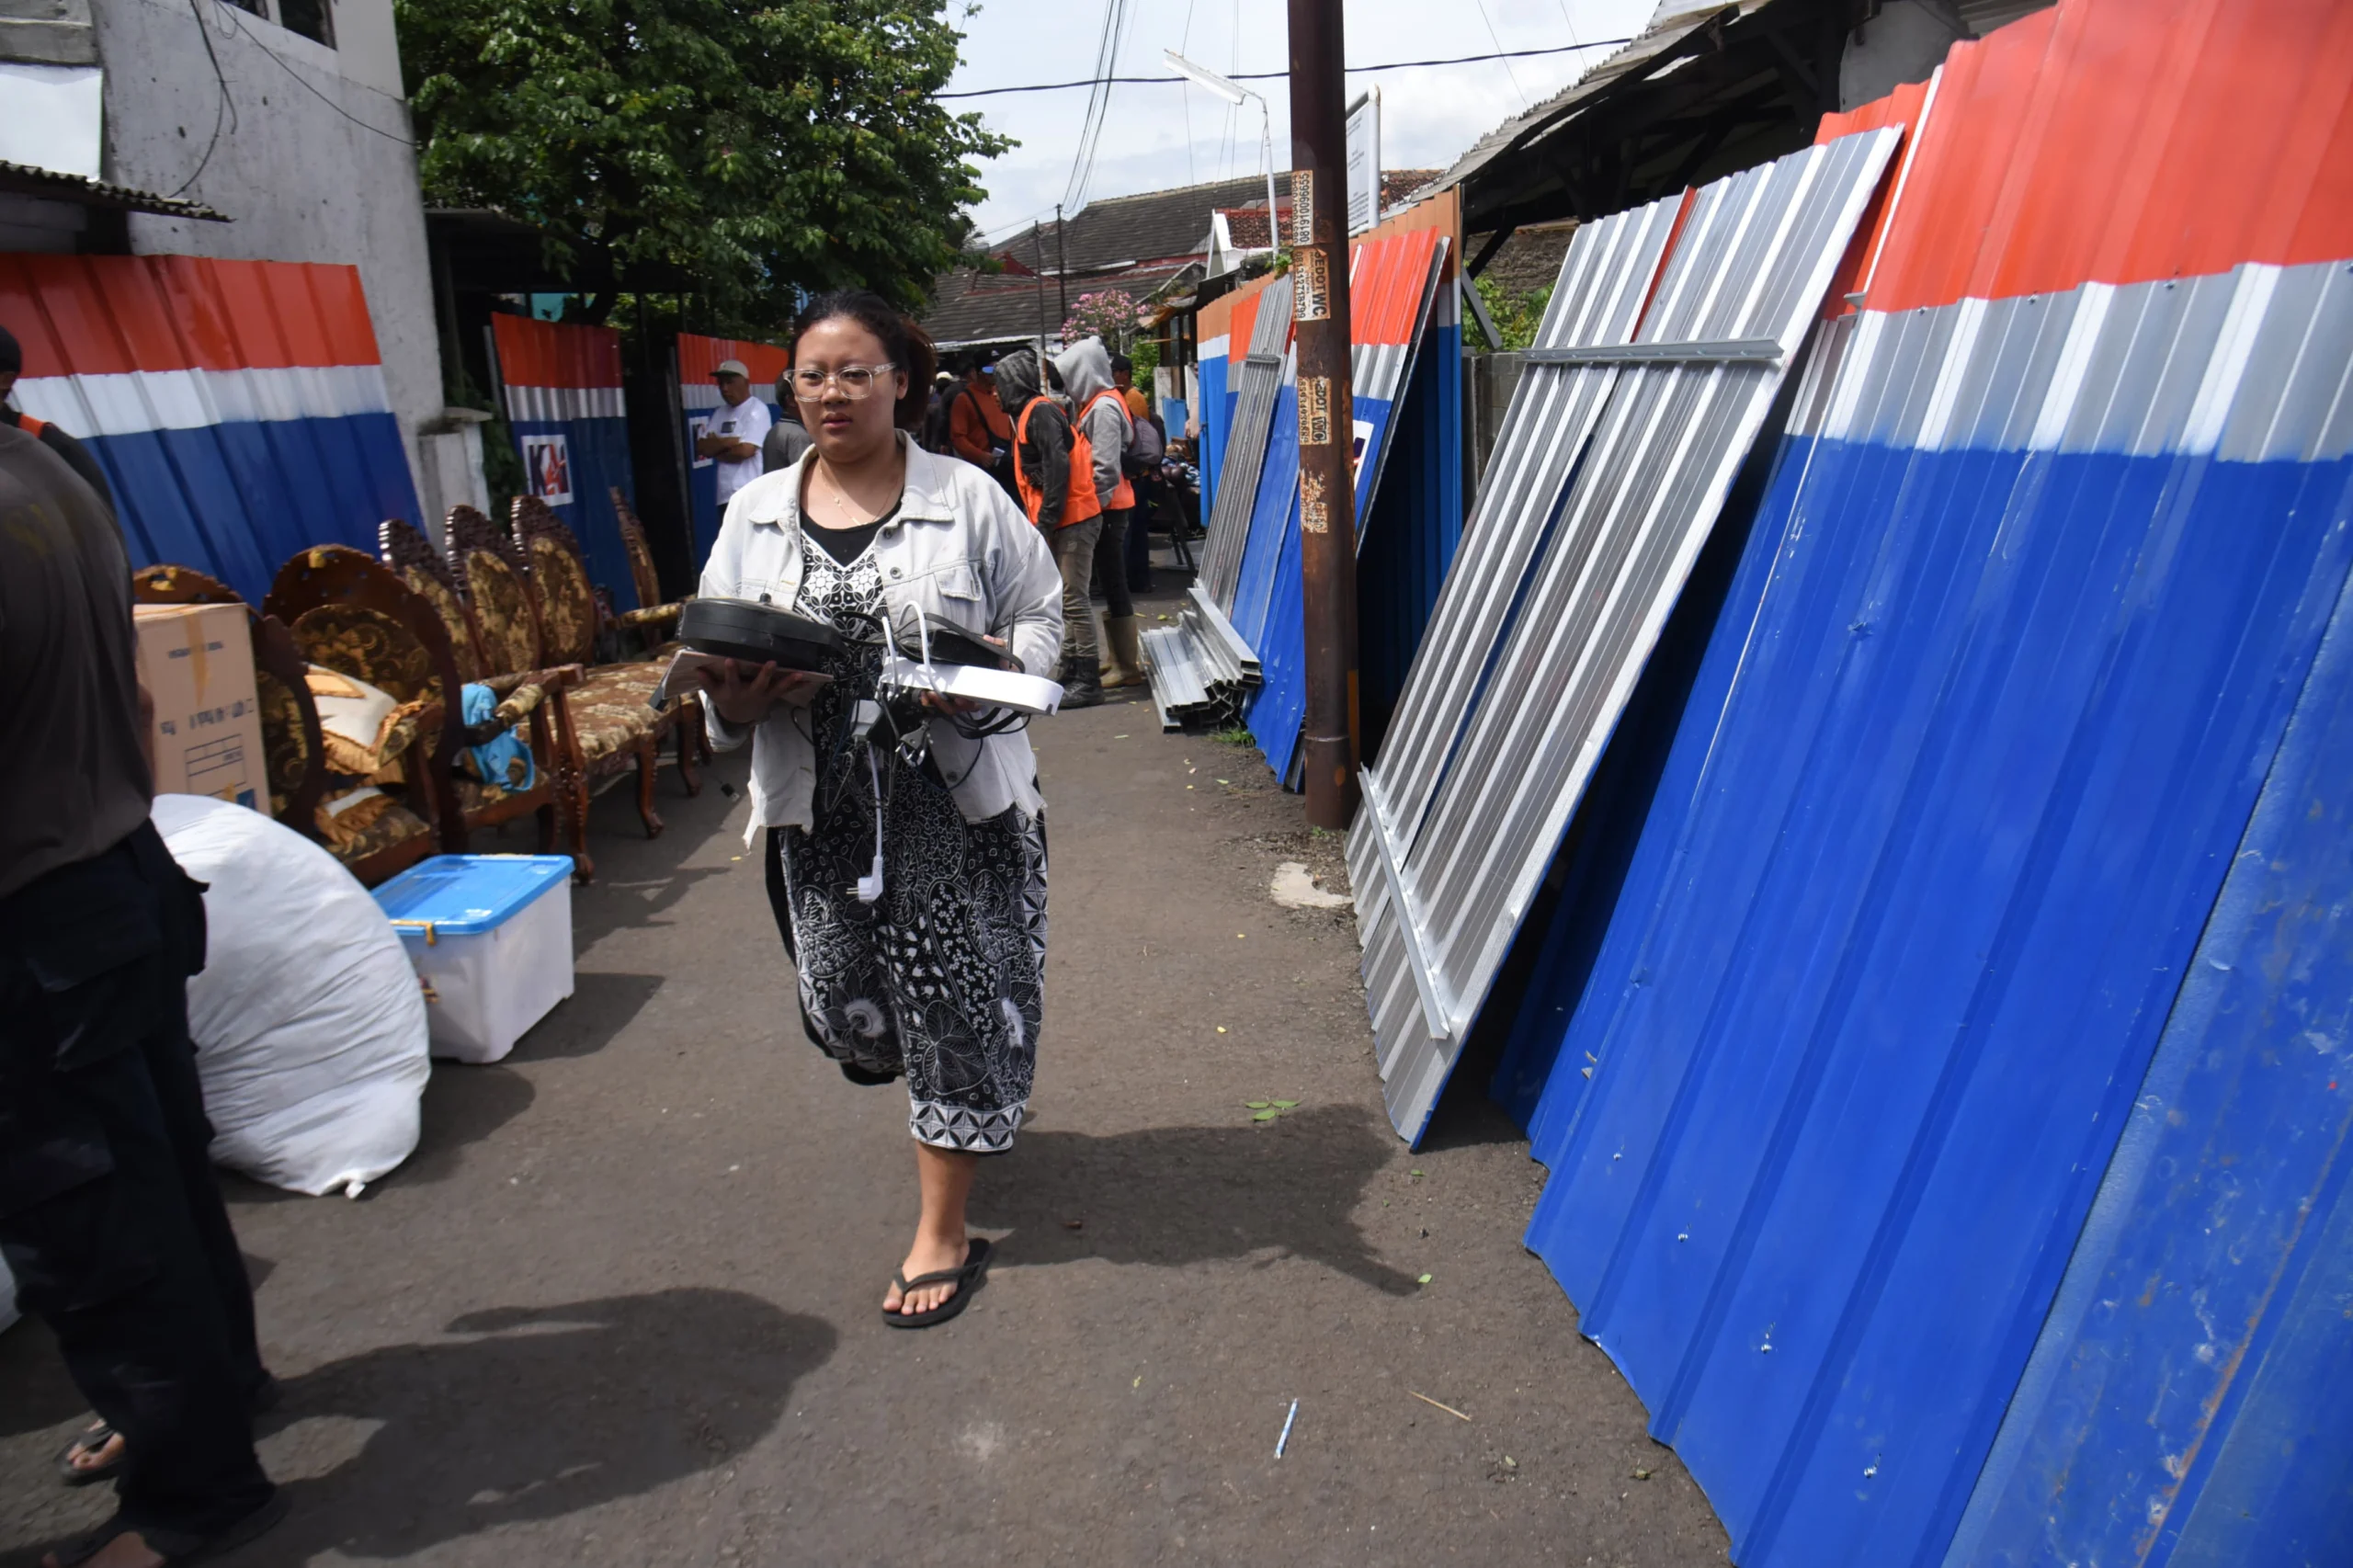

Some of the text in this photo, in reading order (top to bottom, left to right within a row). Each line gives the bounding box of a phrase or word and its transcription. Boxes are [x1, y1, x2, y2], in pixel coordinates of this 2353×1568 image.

[1300, 173, 1310, 243] 081910096655
[1313, 291, 1327, 317] WC
[1312, 416, 1327, 442] WC
